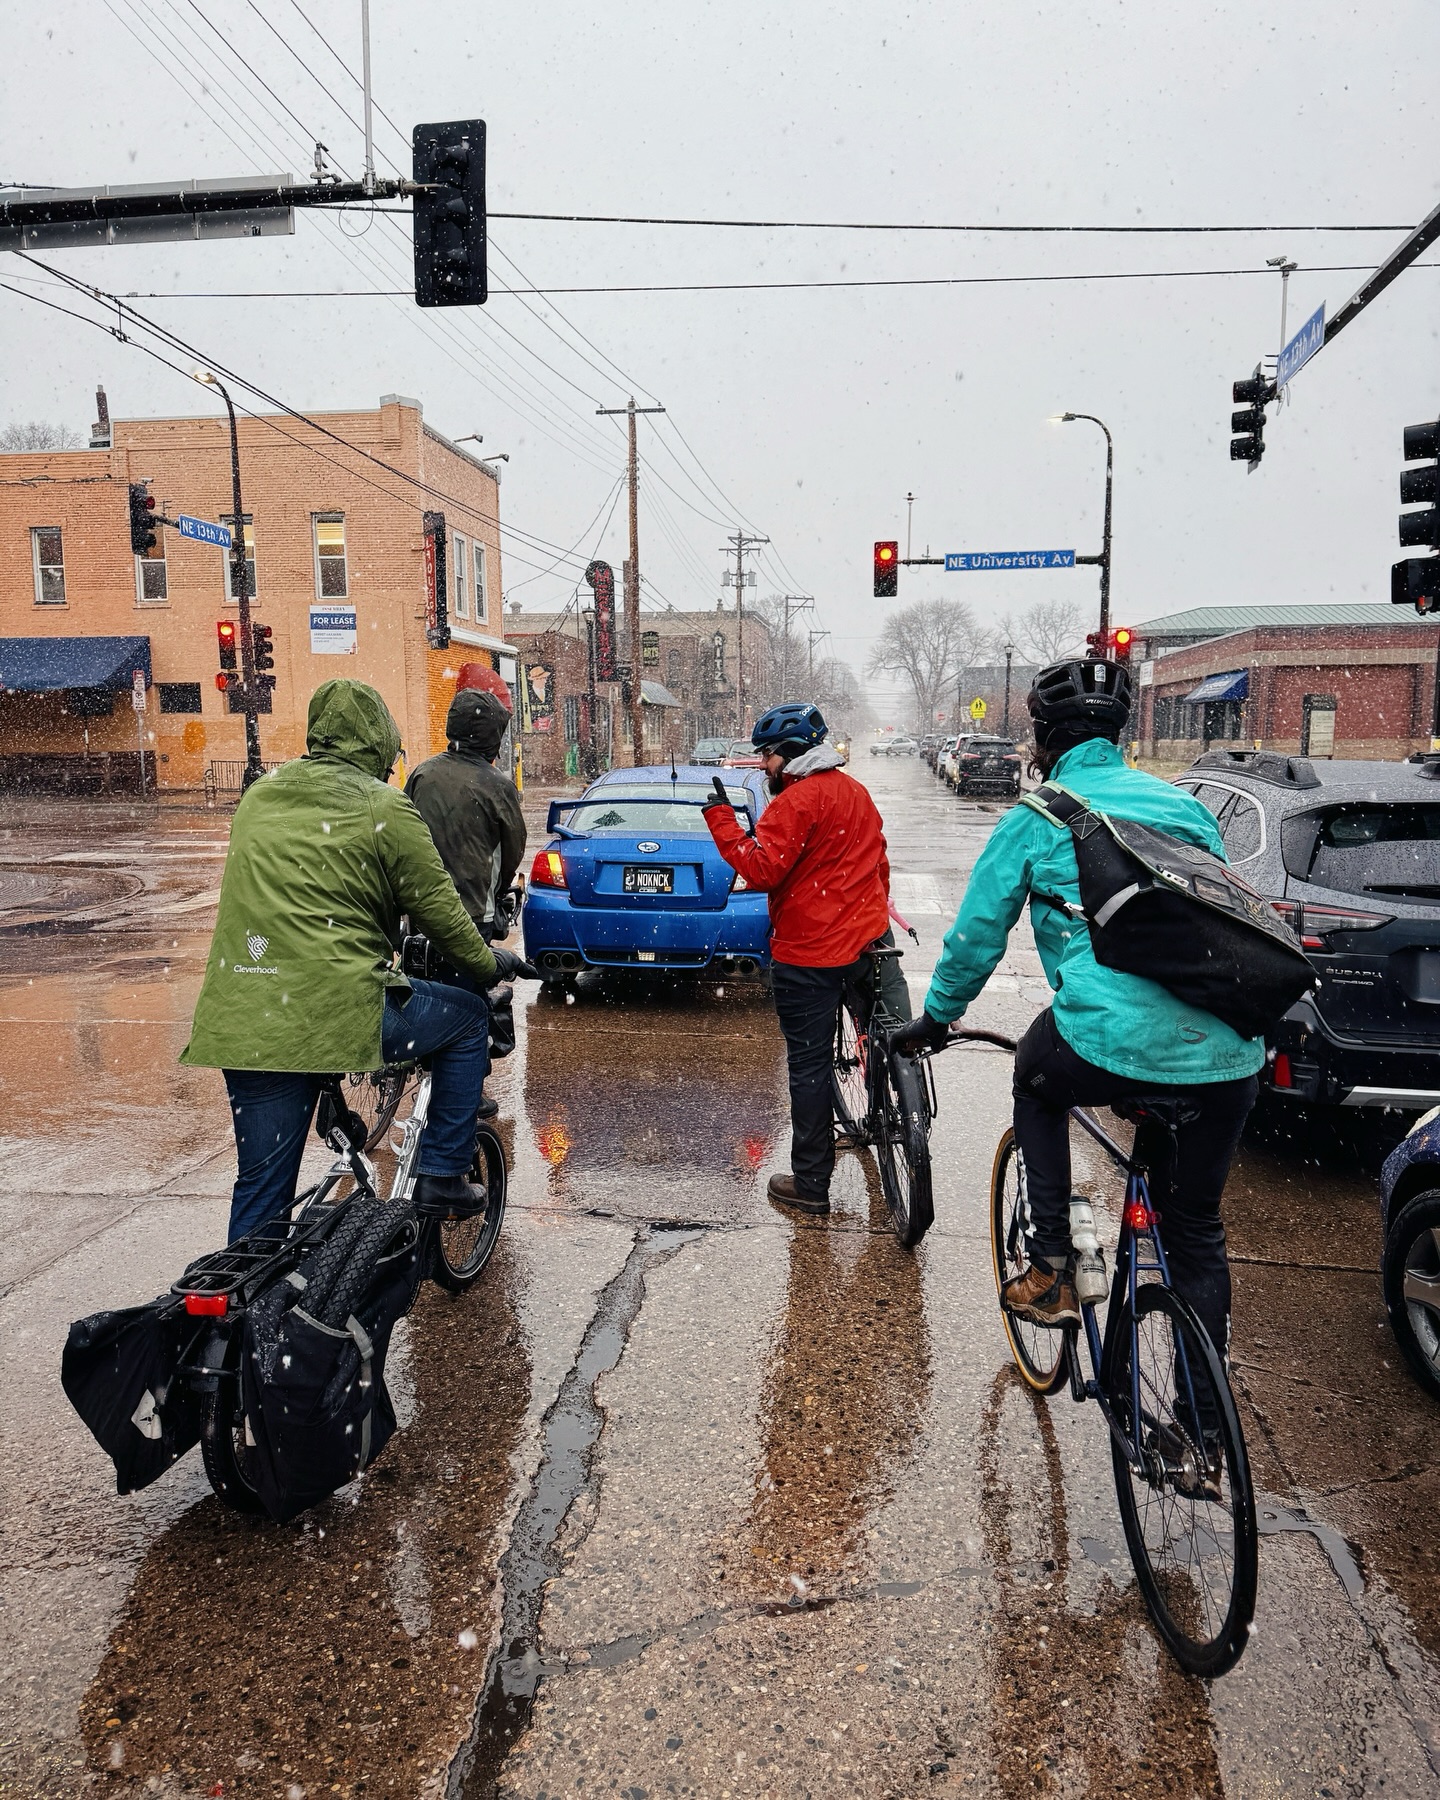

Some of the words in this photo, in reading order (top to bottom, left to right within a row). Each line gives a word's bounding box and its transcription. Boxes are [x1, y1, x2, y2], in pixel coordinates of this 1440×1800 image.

[1280, 355, 1289, 378] NE
[1291, 335, 1307, 367] 13th
[1310, 319, 1322, 347] Av
[182, 520, 194, 534] NE
[197, 524, 216, 540] 13th
[219, 530, 229, 544] Av
[948, 557, 967, 568] NE
[972, 554, 1046, 567] University
[1051, 554, 1071, 565] Av
[313, 617, 329, 625] FOR
[330, 616, 354, 625] LEASE
[714, 636, 723, 680] RITZ
[637, 874, 669, 886] NOKNCK
[234, 965, 277, 974] Cleverhood
[1326, 968, 1382, 978] SUBARU
